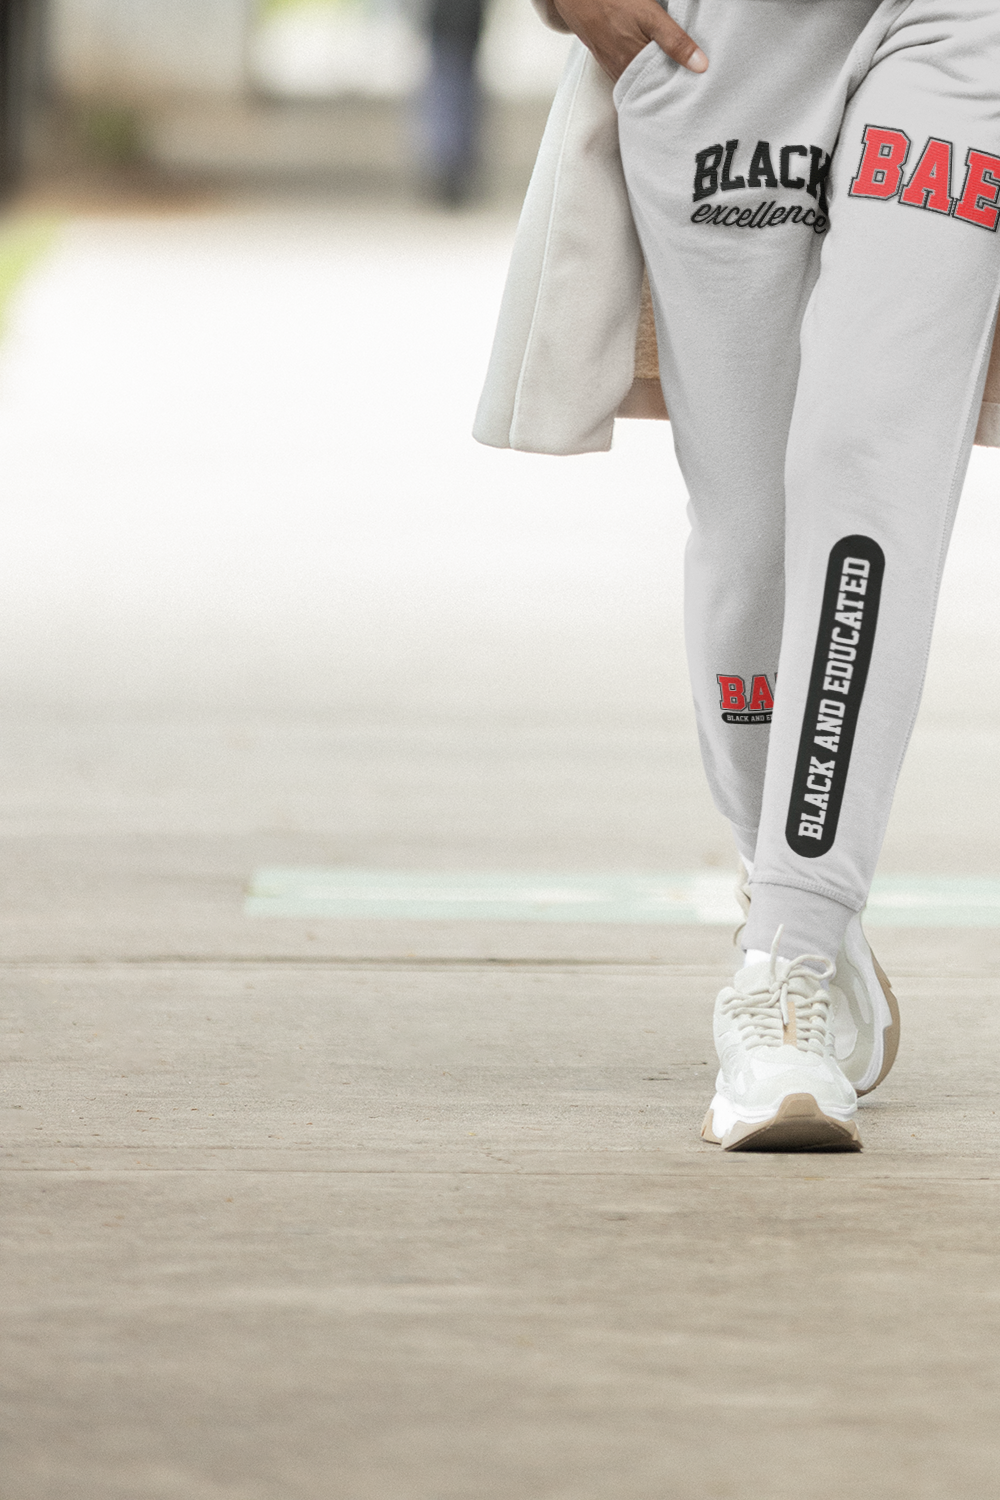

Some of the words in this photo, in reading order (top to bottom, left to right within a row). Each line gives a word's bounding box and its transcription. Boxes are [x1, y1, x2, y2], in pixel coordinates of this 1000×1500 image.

[692, 139, 831, 216] BLACK
[691, 200, 827, 234] excellence
[822, 556, 871, 695] EDUCATED
[716, 672, 778, 712] BA
[726, 714, 749, 722] BLACK
[813, 698, 846, 753] AND
[797, 756, 836, 840] BLACK
